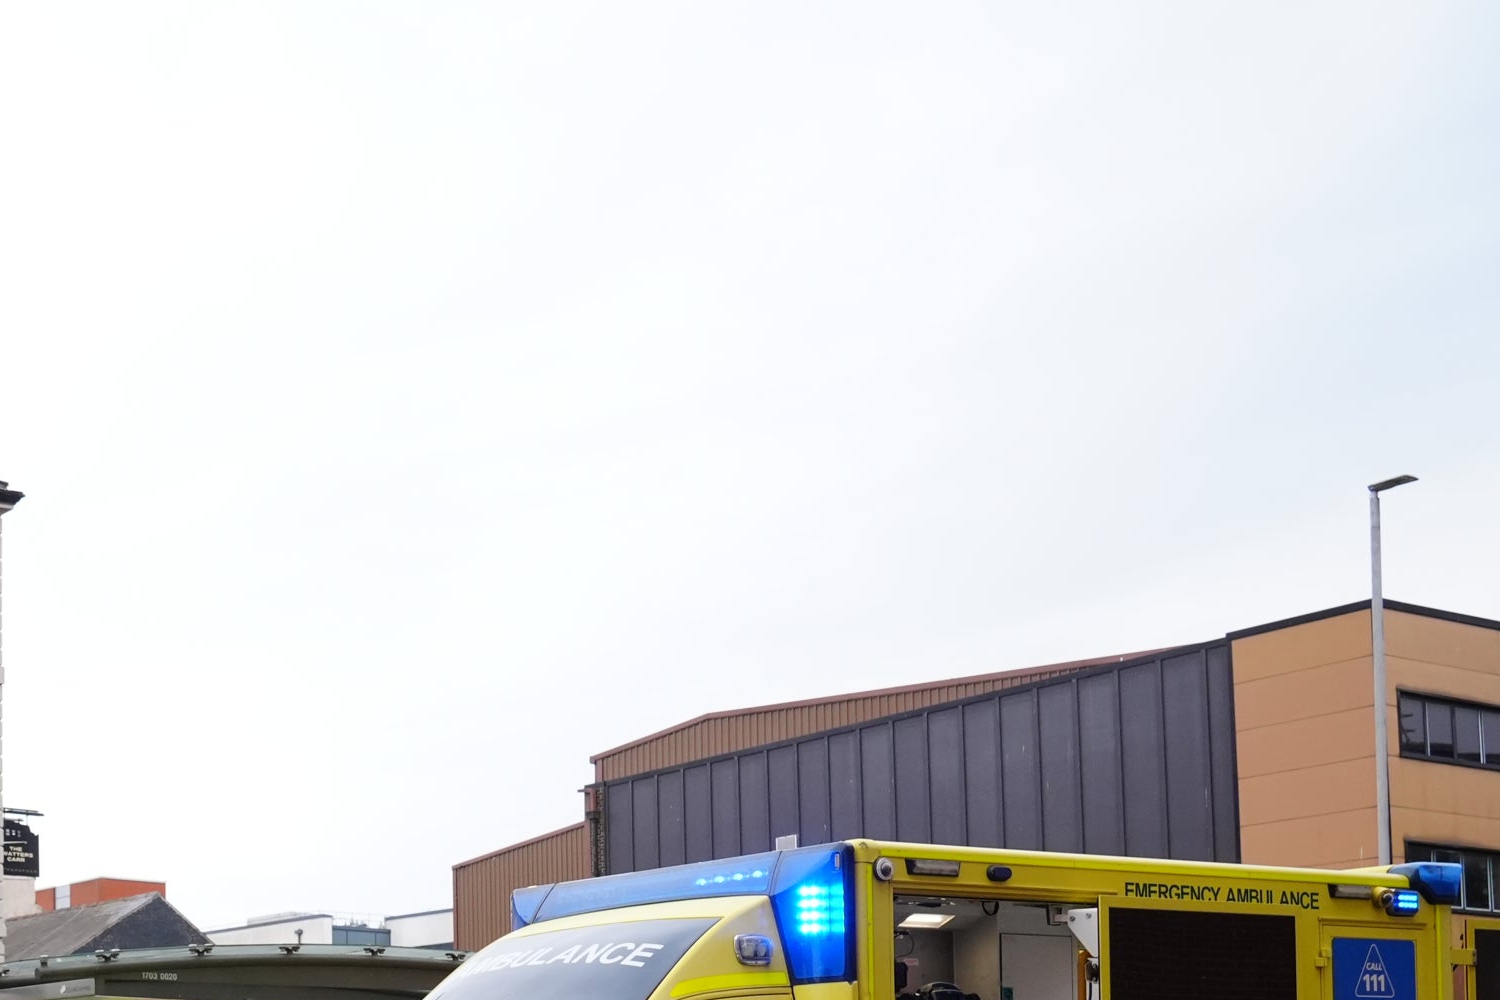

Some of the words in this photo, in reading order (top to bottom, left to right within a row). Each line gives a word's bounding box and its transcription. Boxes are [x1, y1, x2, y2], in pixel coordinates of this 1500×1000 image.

[1125, 882, 1220, 901] EMERGENCY
[1226, 888, 1319, 910] AMBULANCE
[1366, 962, 1382, 970] CALL
[1362, 974, 1385, 992] 111
